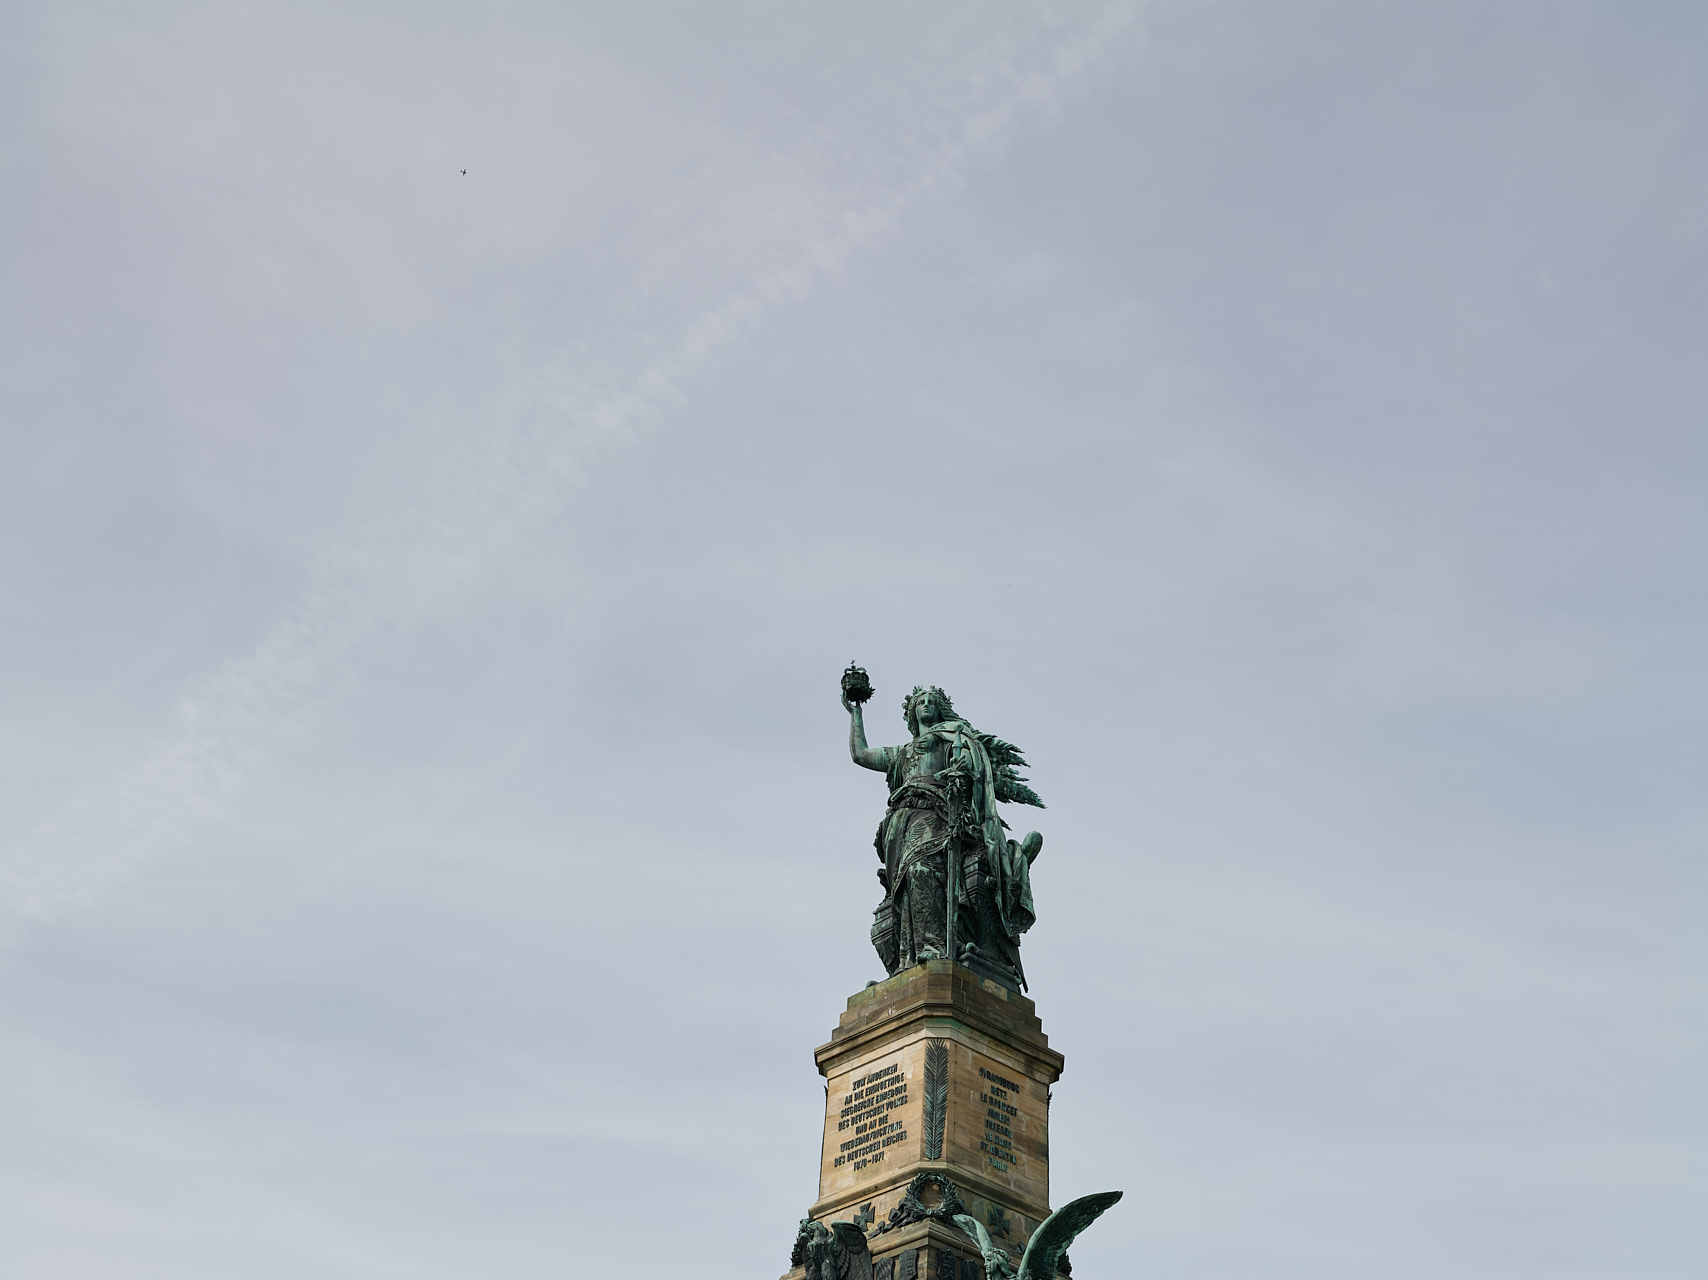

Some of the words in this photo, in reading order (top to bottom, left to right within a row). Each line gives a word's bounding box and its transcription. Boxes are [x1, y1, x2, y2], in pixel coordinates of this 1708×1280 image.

[853, 1077, 866, 1091] ZUM
[867, 1063, 898, 1085] ANDENKEN
[979, 1067, 1019, 1094] STRASSBURG
[841, 1097, 874, 1119] SIEGREICHE
[876, 1084, 907, 1104] ERHEBUNG
[845, 1094, 852, 1106] AN
[854, 1089, 864, 1101] DIE
[991, 1085, 1008, 1100] METZ
[838, 1119, 849, 1131] DES
[851, 1104, 884, 1127] DEUTSCHEN
[886, 1095, 908, 1111] VOLKES
[980, 1092, 988, 1103] LE
[989, 1096, 1018, 1117] BOURGET
[840, 1120, 902, 1152] WIEDERAUFRICHTUNG
[856, 1125, 867, 1135] UND
[868, 1119, 877, 1130] AN
[878, 1114, 888, 1125] DIE
[985, 1119, 1013, 1138] ORLEANS
[834, 1155, 845, 1167] DES
[847, 1140, 881, 1163] DEUTSCHEN
[881, 1130, 907, 1148] REICHES
[985, 1131, 993, 1141] LE
[994, 1134, 1011, 1150] MANS
[989, 1156, 1008, 1173] PARIS
[990, 1145, 1016, 1165] QUENTIN
